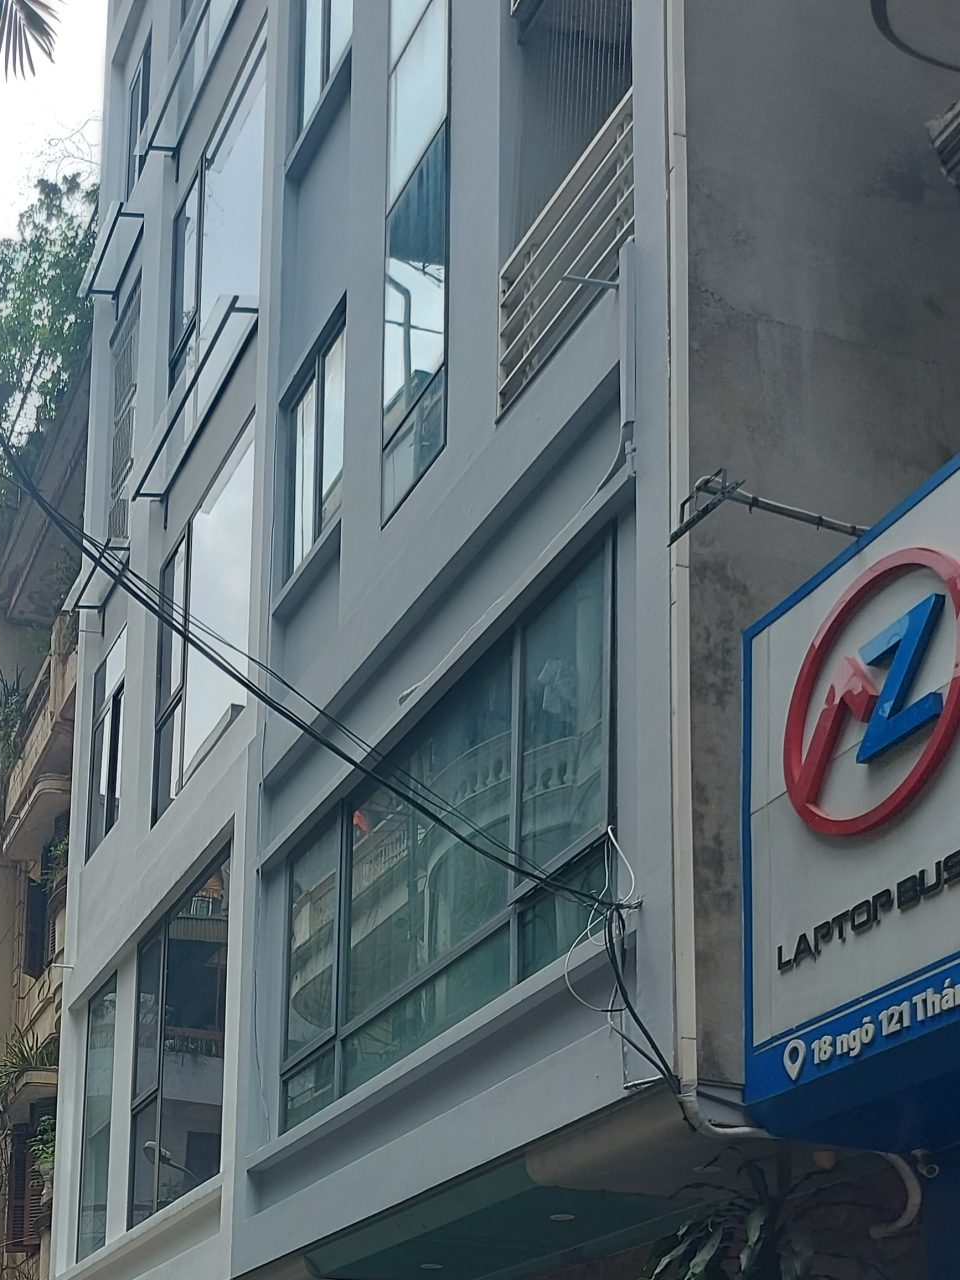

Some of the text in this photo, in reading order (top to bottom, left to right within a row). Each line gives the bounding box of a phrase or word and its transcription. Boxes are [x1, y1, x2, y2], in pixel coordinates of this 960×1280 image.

[777, 888, 895, 973] LAPTOP
[811, 1035, 833, 1064] 18
[835, 1015, 876, 1057] ngõ
[878, 1001, 912, 1036] 121
